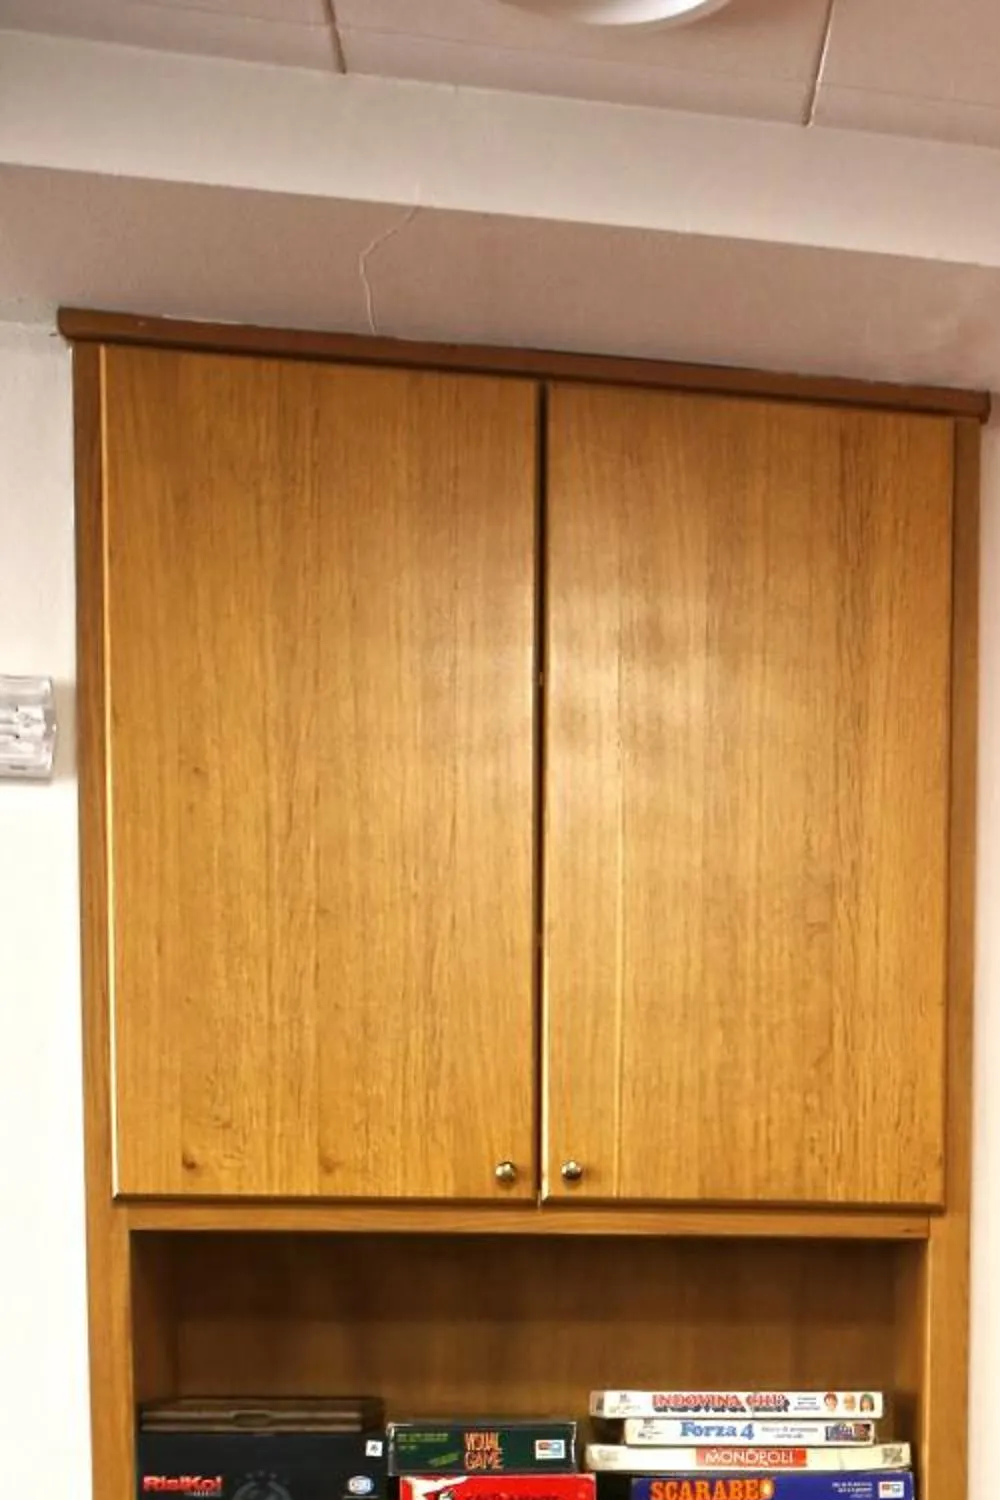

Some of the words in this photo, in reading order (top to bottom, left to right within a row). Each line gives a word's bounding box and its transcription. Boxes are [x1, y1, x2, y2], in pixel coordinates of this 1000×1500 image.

[652, 1394, 746, 1412] INDOVINA
[746, 1393, 790, 1413] CHI?
[680, 1421, 738, 1438] Forza
[740, 1422, 755, 1440] 4
[464, 1451, 503, 1470] GAME
[704, 1447, 794, 1467] MONOPOLI
[143, 1475, 223, 1492] RisiKo!
